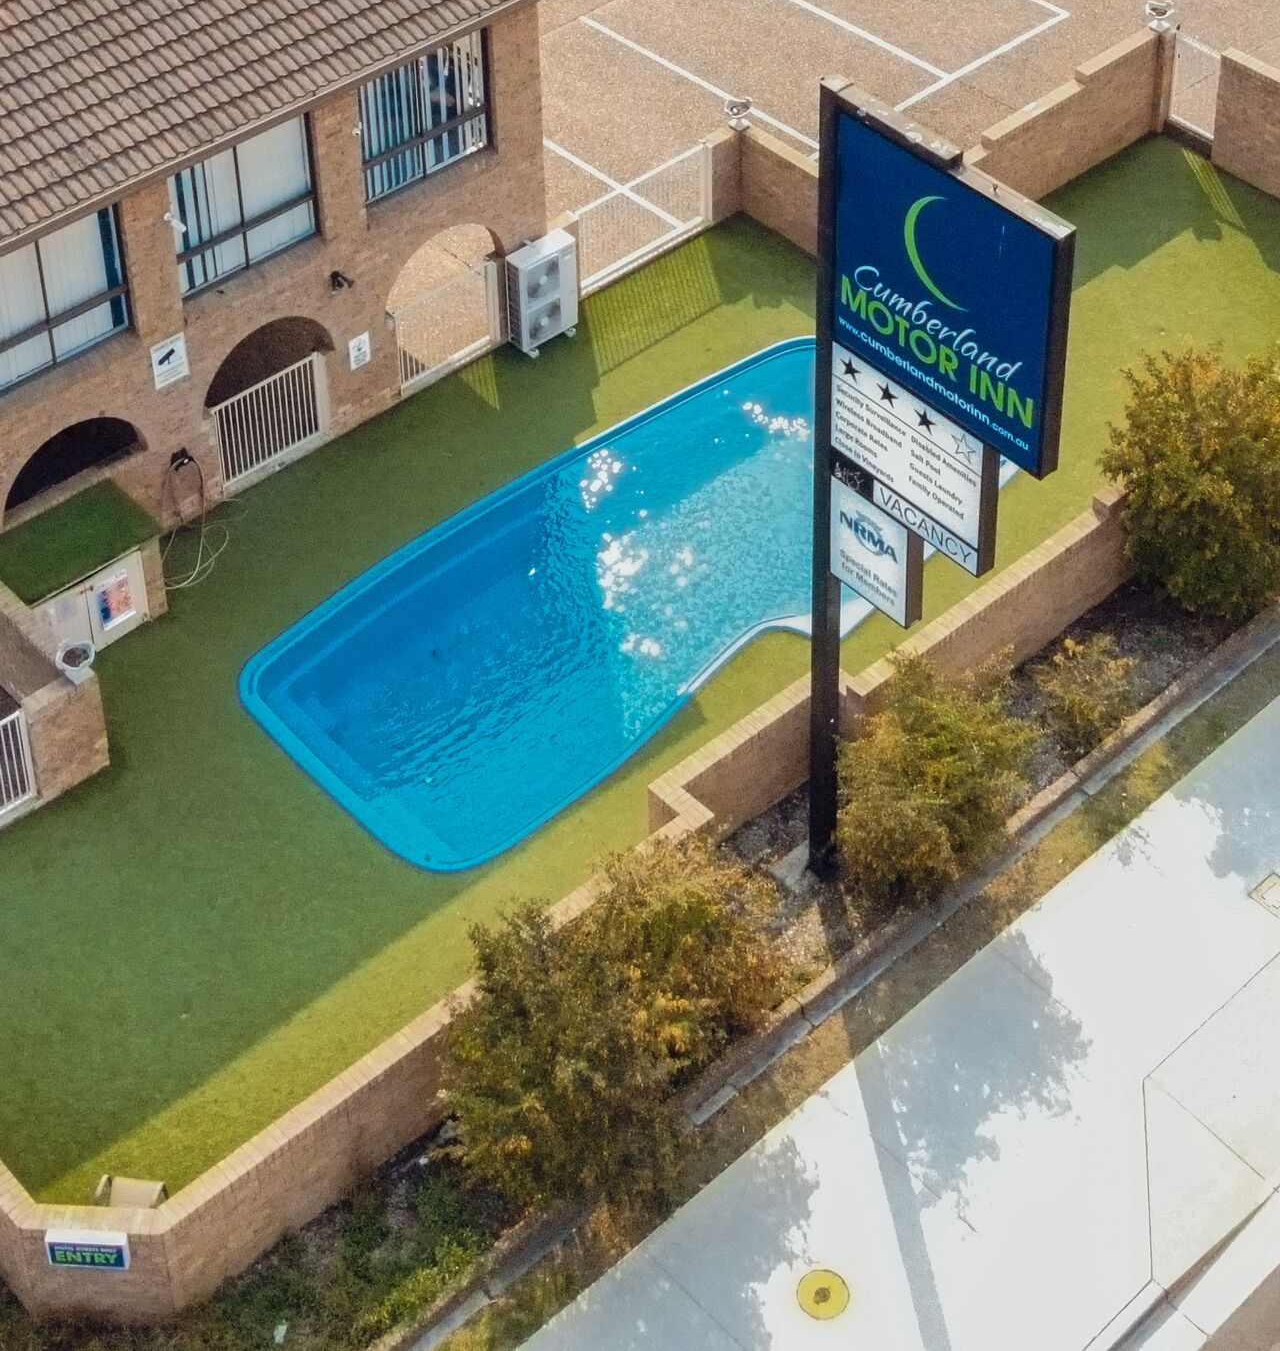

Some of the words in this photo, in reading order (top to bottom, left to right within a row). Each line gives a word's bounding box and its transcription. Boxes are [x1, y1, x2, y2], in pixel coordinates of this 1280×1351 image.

[854, 265, 1023, 381] Cumberland
[841, 274, 959, 382] MOTOR
[969, 364, 1034, 429] INN
[838, 316, 1029, 451] www.cumberlandmotorinn.com.au
[835, 397, 864, 422] Wireless
[865, 418, 902, 448] Broadband
[835, 411, 868, 438] Corporate
[869, 434, 888, 452] Rates
[836, 384, 864, 408] Security
[865, 404, 906, 437] Surveillance
[834, 436, 853, 453] Close
[861, 454, 894, 483] Vineyards
[835, 423, 854, 441] Large
[854, 437, 878, 458] Rooms
[910, 449, 924, 464] Salt
[925, 460, 941, 475] Pool
[911, 435, 941, 461] Disabled
[942, 458, 977, 487] Amenities
[908, 475, 930, 496] Family
[932, 492, 964, 520] Operated
[909, 462, 933, 484] Guests
[934, 480, 962, 505] Laundry
[840, 510, 898, 564] NRMA
[879, 487, 971, 564] VACANCY
[840, 548, 872, 578] Special
[873, 573, 898, 598] Rates
[841, 561, 855, 576] for
[855, 571, 896, 606] Members
[54, 1250, 118, 1264] ENTRY
